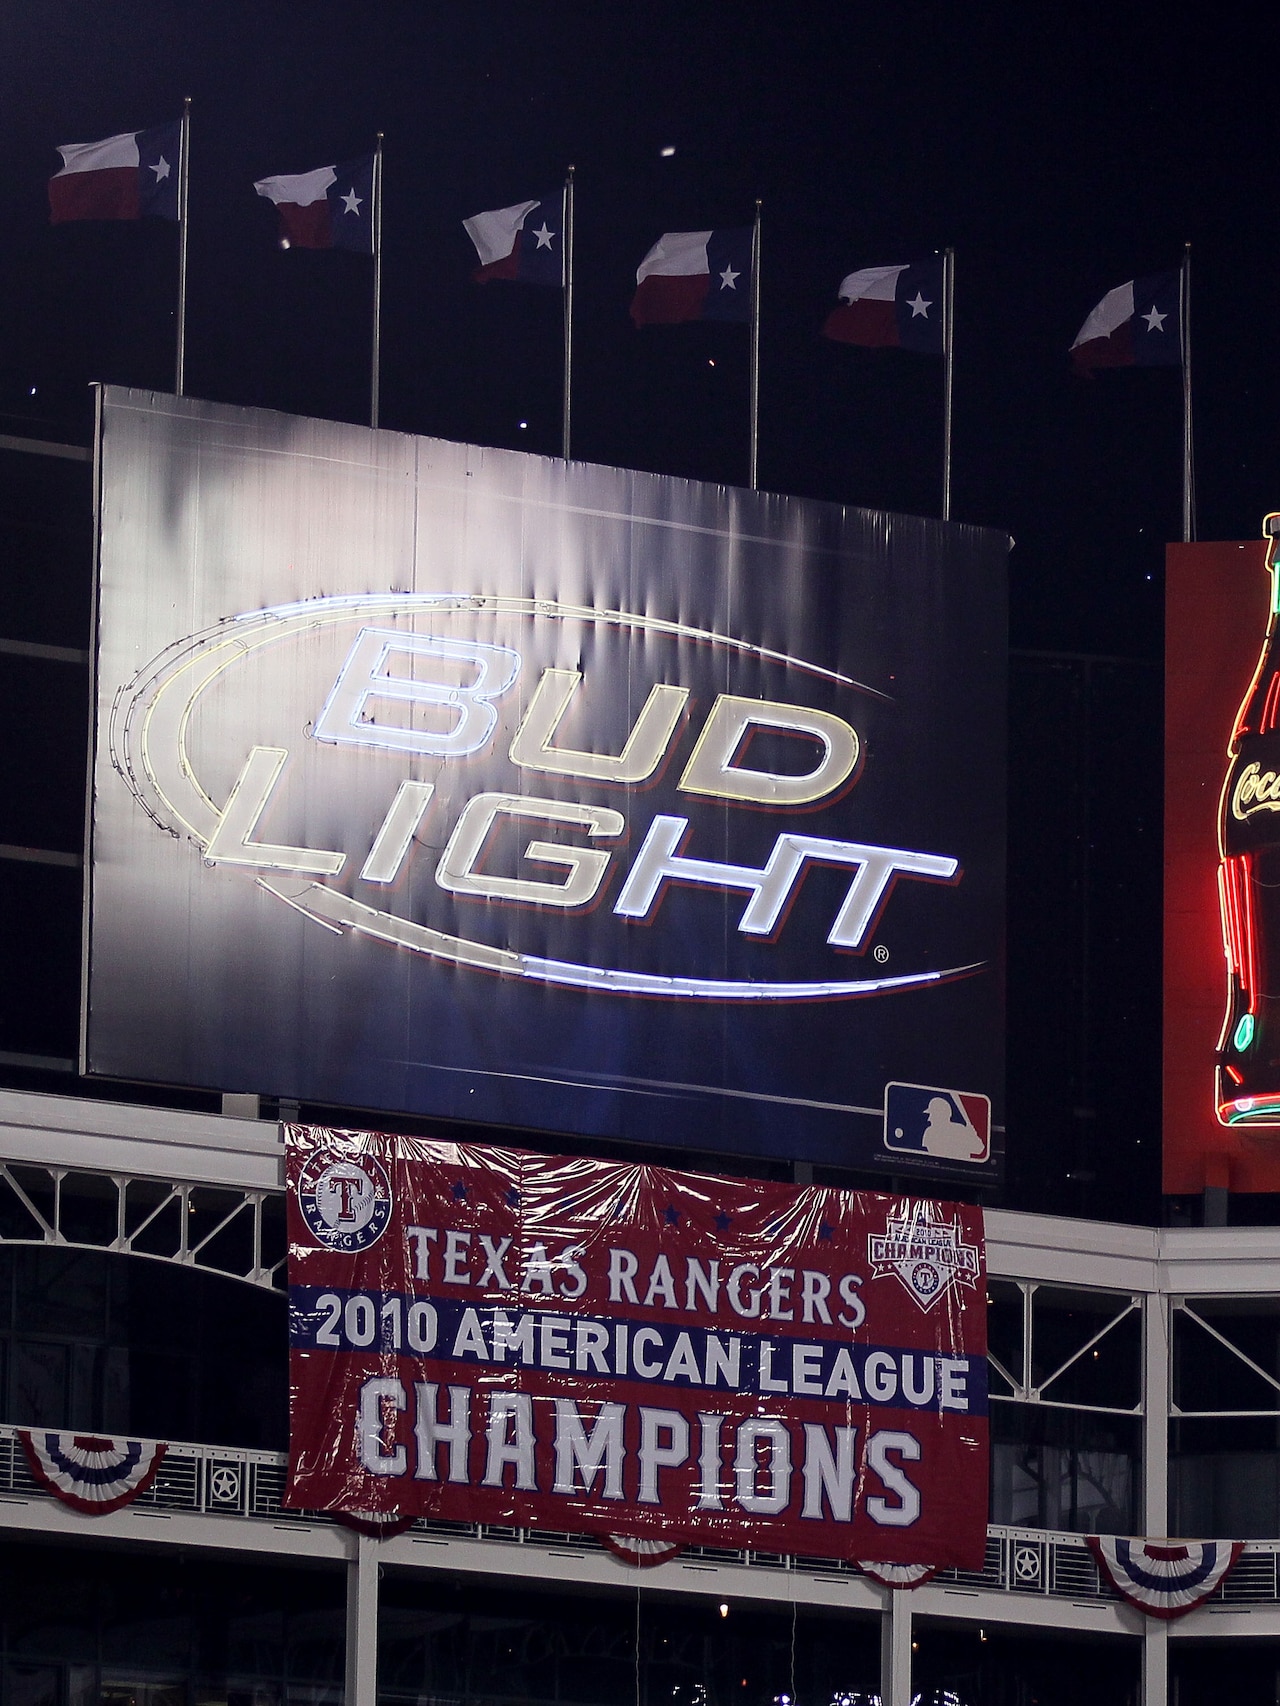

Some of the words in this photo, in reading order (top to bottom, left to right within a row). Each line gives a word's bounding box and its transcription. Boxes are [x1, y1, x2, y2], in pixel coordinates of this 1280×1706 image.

[312, 625, 861, 805] BUD
[202, 745, 960, 948] LIGHT
[407, 1224, 588, 1298] TEXAS
[607, 1247, 867, 1329] RANGERS
[315, 1293, 438, 1353] 2010
[452, 1307, 741, 1388] AMERICAN
[759, 1340, 970, 1410] LEAGUE
[358, 1377, 923, 1526] CHAMPIONS
